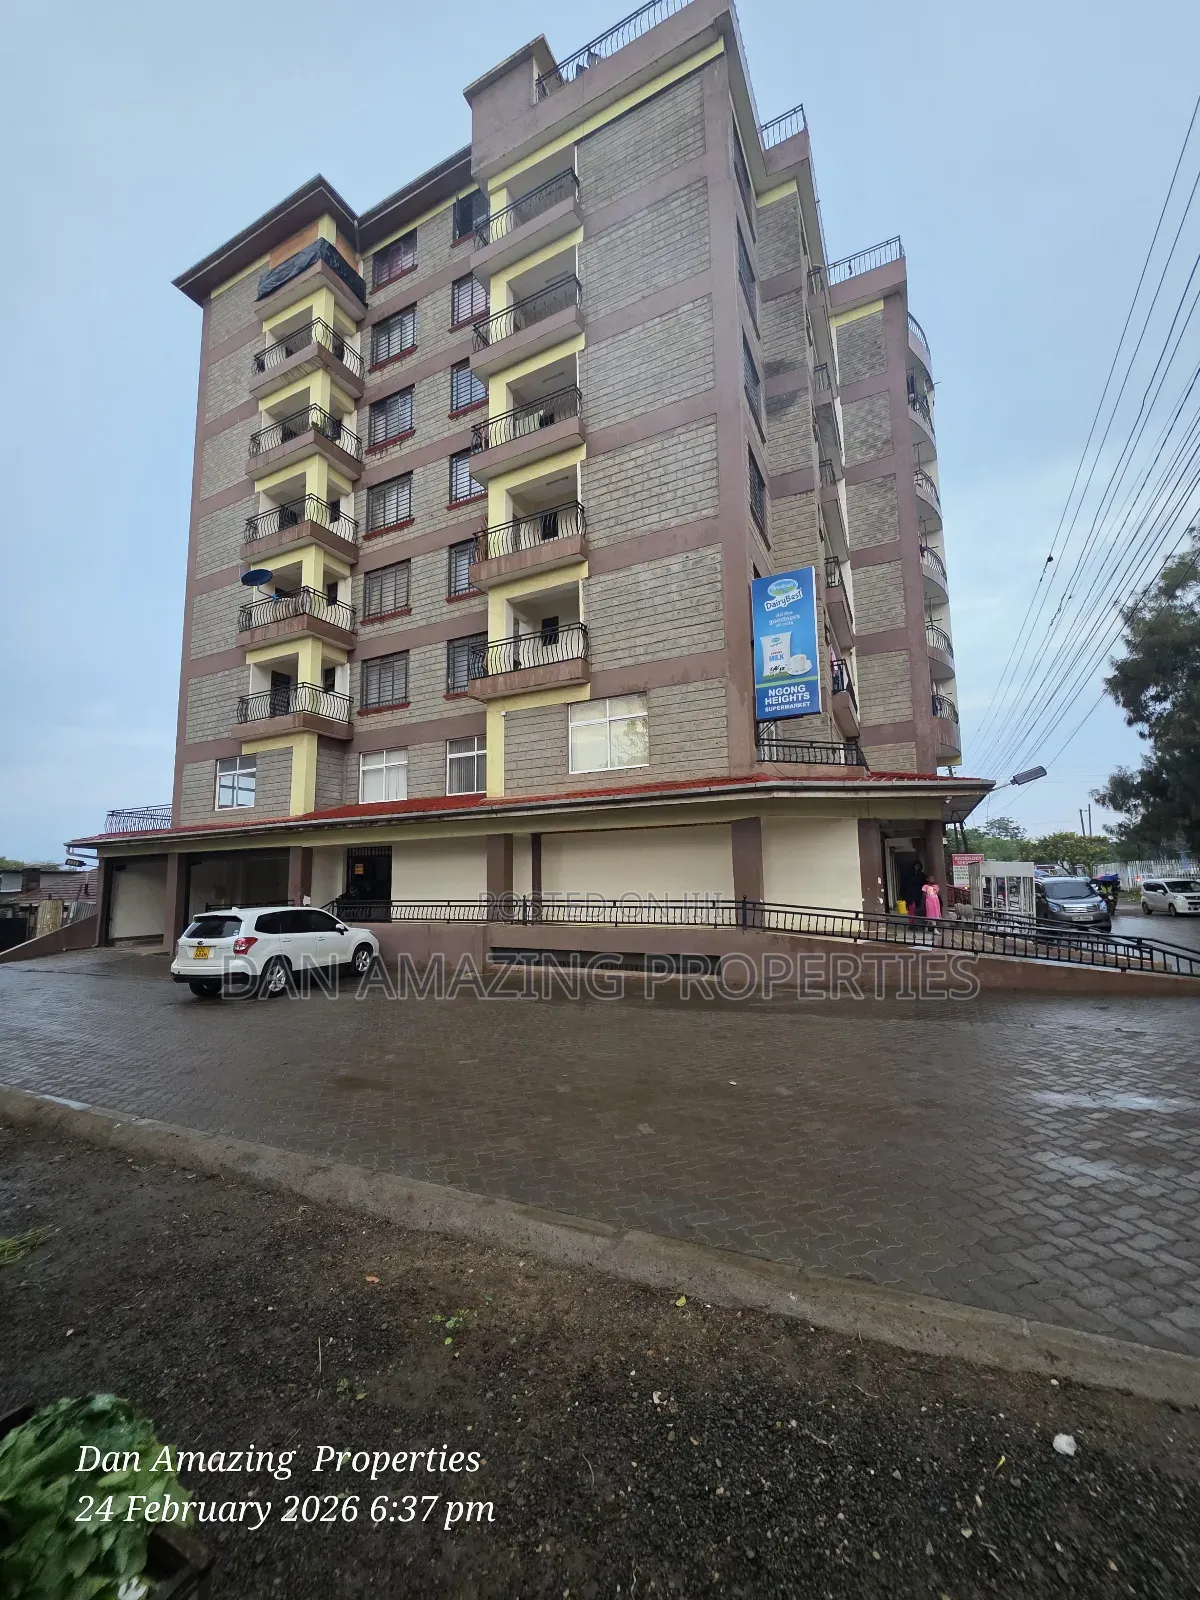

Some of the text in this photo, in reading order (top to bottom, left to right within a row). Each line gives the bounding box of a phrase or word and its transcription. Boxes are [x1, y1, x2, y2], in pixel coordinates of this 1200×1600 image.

[766, 591, 802, 610] DairyBest
[768, 615, 800, 626] goodness
[768, 685, 806, 697] NGONG
[764, 692, 810, 705] HEIGHTS
[764, 702, 811, 712] SUPERMARKET
